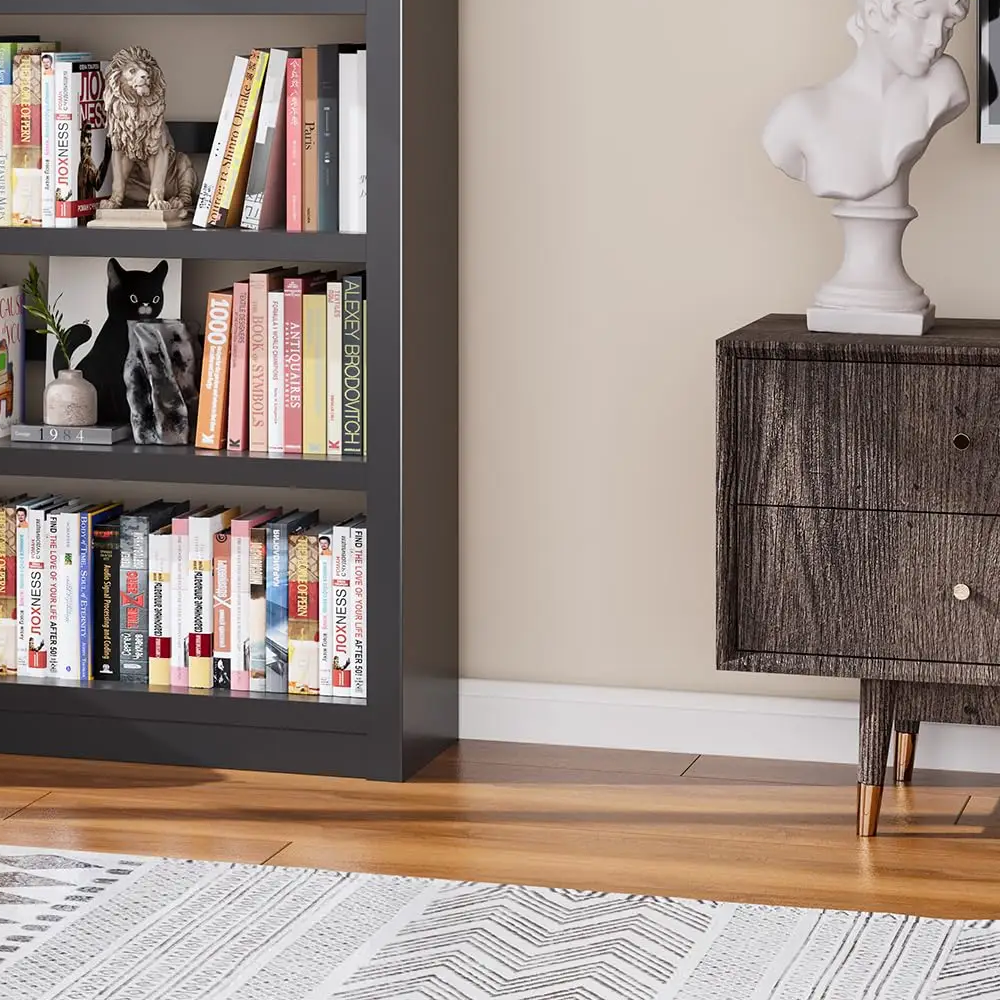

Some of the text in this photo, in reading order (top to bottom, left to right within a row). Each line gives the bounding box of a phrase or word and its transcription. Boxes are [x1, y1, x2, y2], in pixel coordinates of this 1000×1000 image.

[20, 108, 30, 120] OF
[222, 84, 252, 168] Shinro Ohtake
[21, 120, 30, 142] PERN
[304, 122, 315, 150] Paris
[58, 123, 69, 185] ЛОХNESS
[207, 299, 229, 345] 1000
[252, 316, 264, 427] BOOK SYMBOLS
[290, 322, 300, 408] ANTIQUAIRES
[344, 280, 360, 443] ALEXEY BRODOVITCH
[40, 428, 85, 443] 1984
[50, 571, 57, 581] OF
[102, 581, 111, 599] Signal
[297, 584, 308, 595] OF
[31, 571, 41, 635] ЛОХNESS
[297, 595, 308, 617] PERN
[355, 588, 362, 598] OF
[102, 600, 111, 628] Processing
[336, 589, 347, 654] ЛОХNESS
[102, 640, 111, 659] Coding
